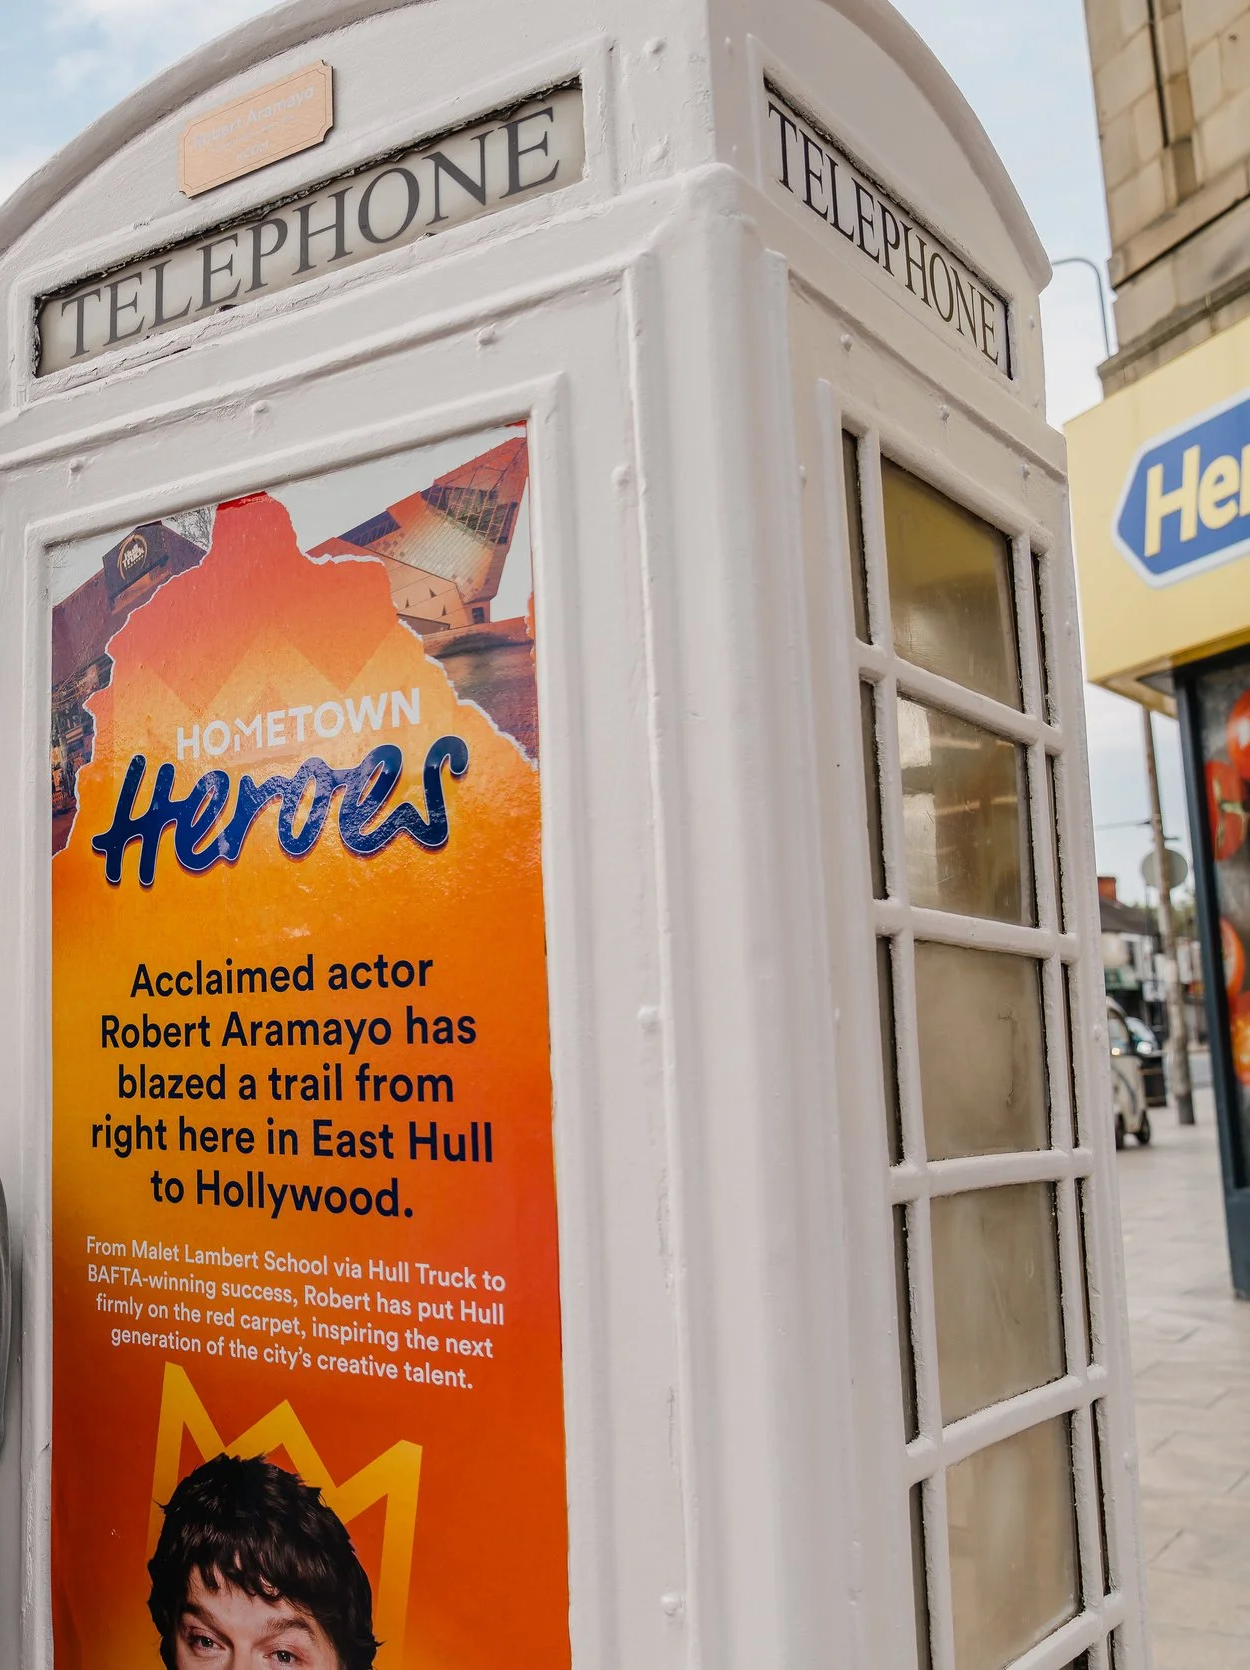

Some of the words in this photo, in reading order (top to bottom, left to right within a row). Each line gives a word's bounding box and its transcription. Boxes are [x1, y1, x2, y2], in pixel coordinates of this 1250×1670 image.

[61, 106, 560, 360] TELEPHONE
[768, 100, 999, 366] TELEPHONE
[176, 687, 421, 762] HOMETOWN
[91, 734, 470, 888] Heroes
[130, 953, 314, 998] Acclaimed
[327, 954, 434, 990] actor
[101, 1013, 211, 1049] Robert
[221, 1011, 392, 1055] Aramayo
[406, 1005, 477, 1045] has
[118, 1063, 226, 1100] blazed
[238, 1073, 257, 1100] a
[268, 1062, 343, 1101] trail
[355, 1062, 454, 1103] from
[92, 1113, 167, 1159] right
[179, 1115, 255, 1154] here
[267, 1117, 299, 1156] in
[313, 1119, 394, 1160] East
[409, 1121, 493, 1163] Hull
[150, 1170, 184, 1204] to
[196, 1169, 414, 1220] Hollywood.
[86, 1235, 126, 1257] From
[131, 1239, 180, 1262] Malet
[184, 1243, 259, 1270] Lambert
[264, 1250, 328, 1276] School
[333, 1256, 362, 1279] via
[368, 1259, 410, 1283] Hull
[415, 1262, 478, 1290] Truck
[482, 1271, 506, 1292] to
[87, 1263, 217, 1300] BAFTA-winning
[221, 1281, 299, 1308] success,
[304, 1284, 371, 1312] Robert
[376, 1291, 412, 1316] has
[417, 1300, 454, 1322] put
[460, 1299, 505, 1326] Hull
[96, 1292, 144, 1320] firmly
[148, 1303, 169, 1319] on
[173, 1302, 201, 1324] the
[206, 1307, 235, 1328] red
[240, 1313, 307, 1340] carpet,
[312, 1316, 399, 1352] inspiring
[404, 1327, 439, 1352] the
[445, 1336, 494, 1359] next
[111, 1328, 201, 1353] generation
[206, 1336, 225, 1356] of
[229, 1338, 258, 1361] the
[263, 1343, 312, 1370] city’s
[316, 1353, 399, 1380] creative
[403, 1361, 474, 1390] talent.
